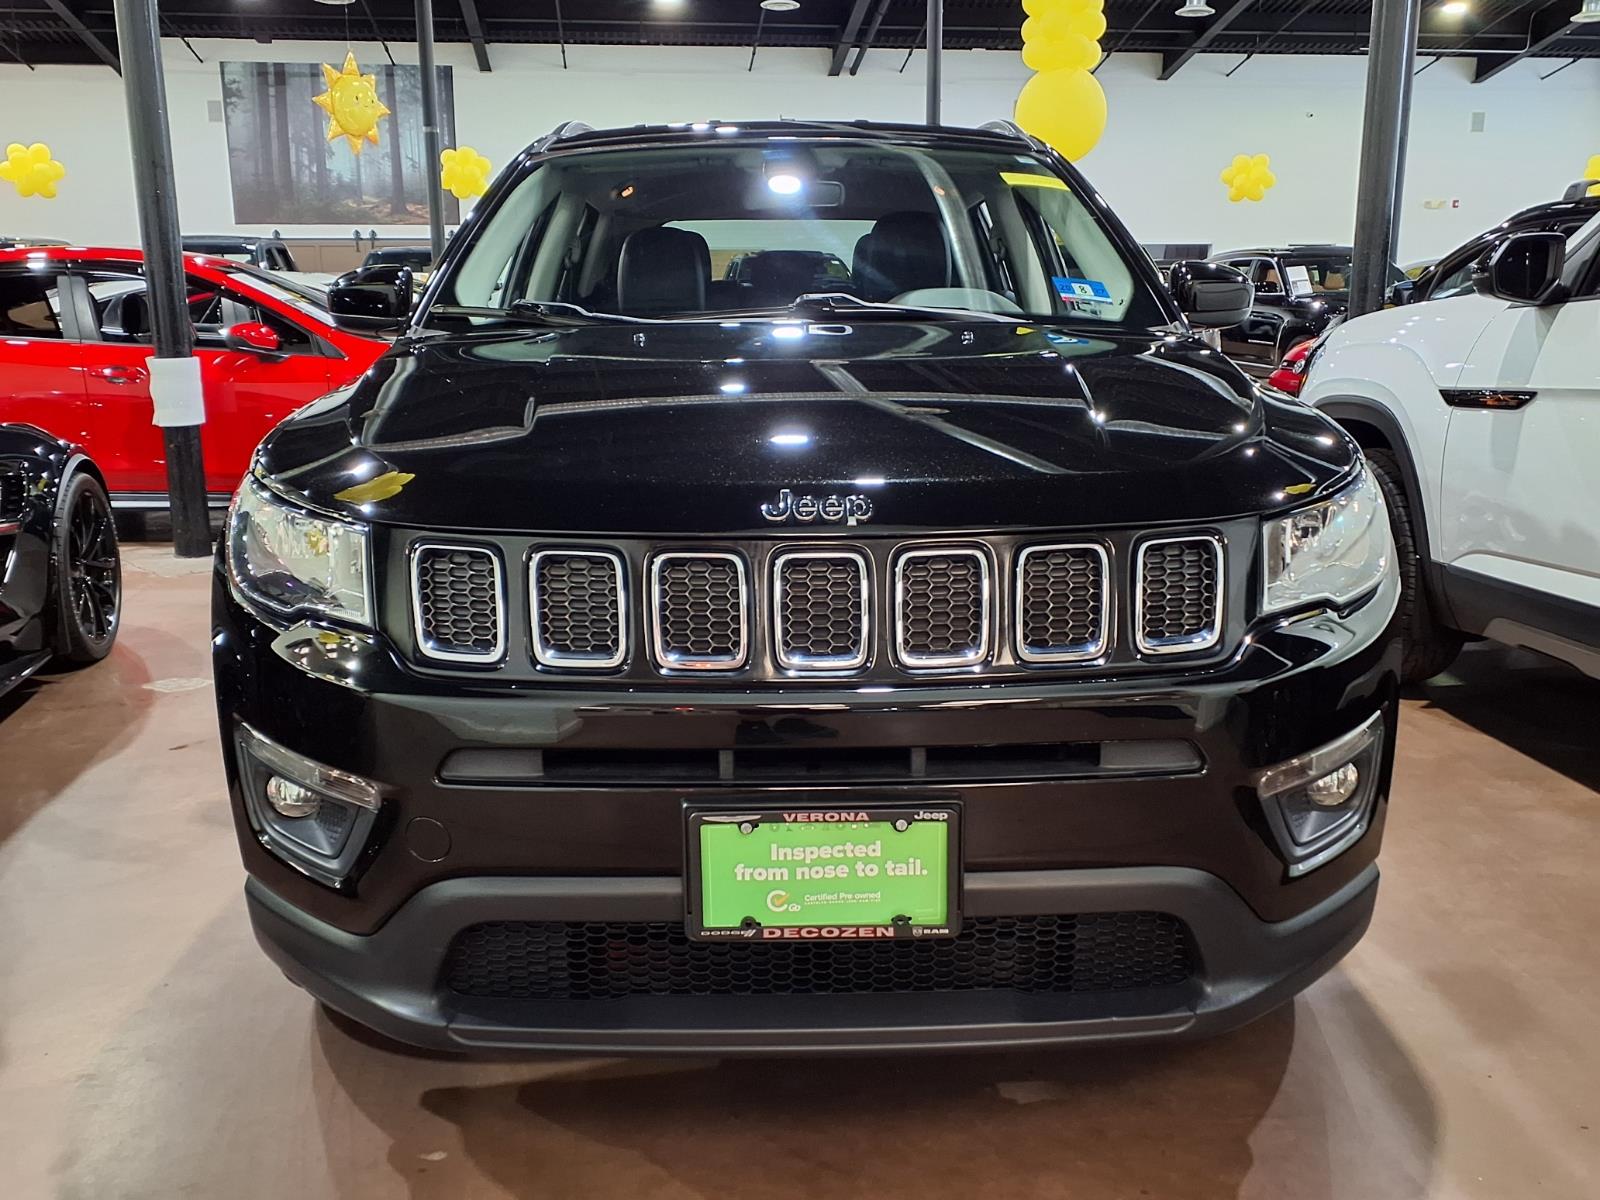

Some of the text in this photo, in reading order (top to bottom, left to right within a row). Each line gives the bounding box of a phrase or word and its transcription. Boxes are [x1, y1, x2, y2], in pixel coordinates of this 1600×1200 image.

[1078, 285, 1088, 294] 8
[760, 488, 873, 526] Jeep
[782, 812, 870, 822] VERONA
[913, 810, 949, 821] Jeep
[770, 840, 882, 864] Inspected
[734, 857, 929, 881] from nose to tail.
[804, 892, 838, 902] Certified
[762, 926, 895, 939] DECOZEN
